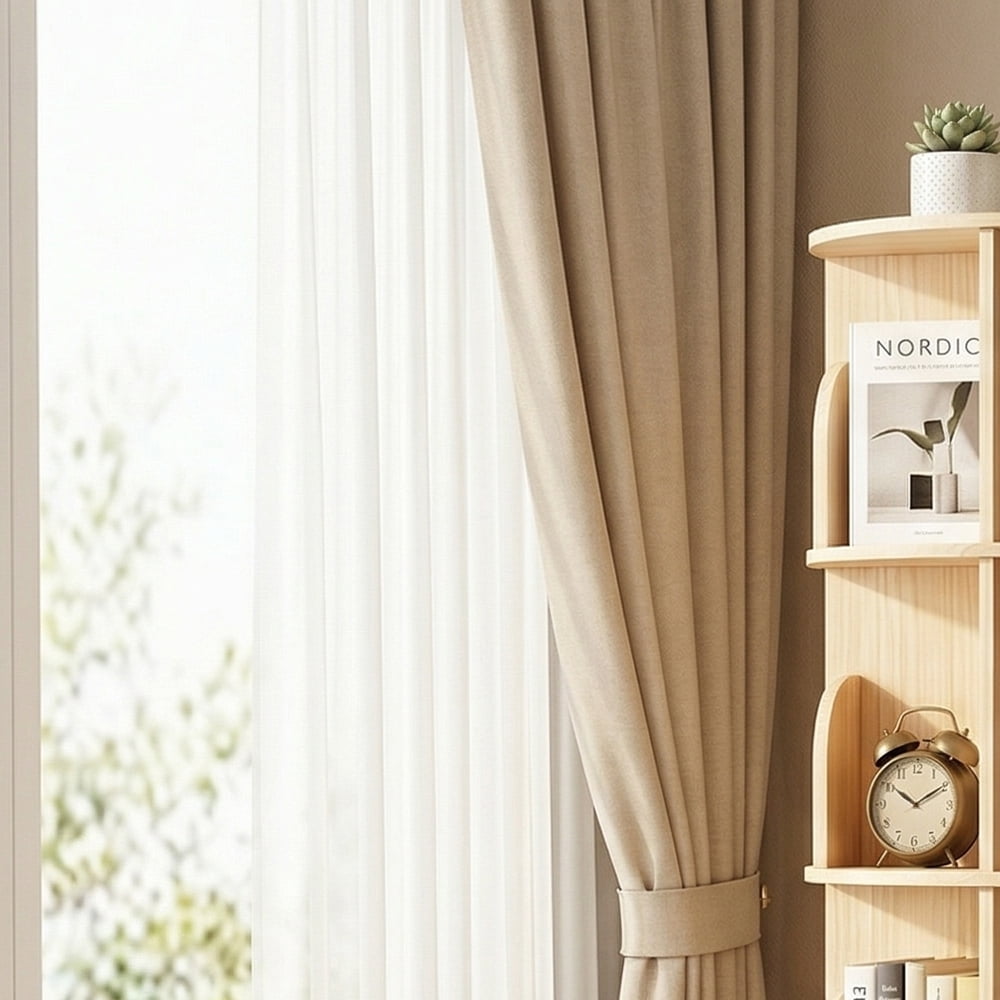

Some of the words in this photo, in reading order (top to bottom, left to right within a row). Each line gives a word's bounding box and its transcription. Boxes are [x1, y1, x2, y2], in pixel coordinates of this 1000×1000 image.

[876, 337, 980, 357] NORDIC
[897, 768, 906, 779] 11
[912, 763, 923, 774] 12
[946, 799, 953, 811] 3
[895, 830, 902, 841] 7
[911, 835, 918, 846] 6
